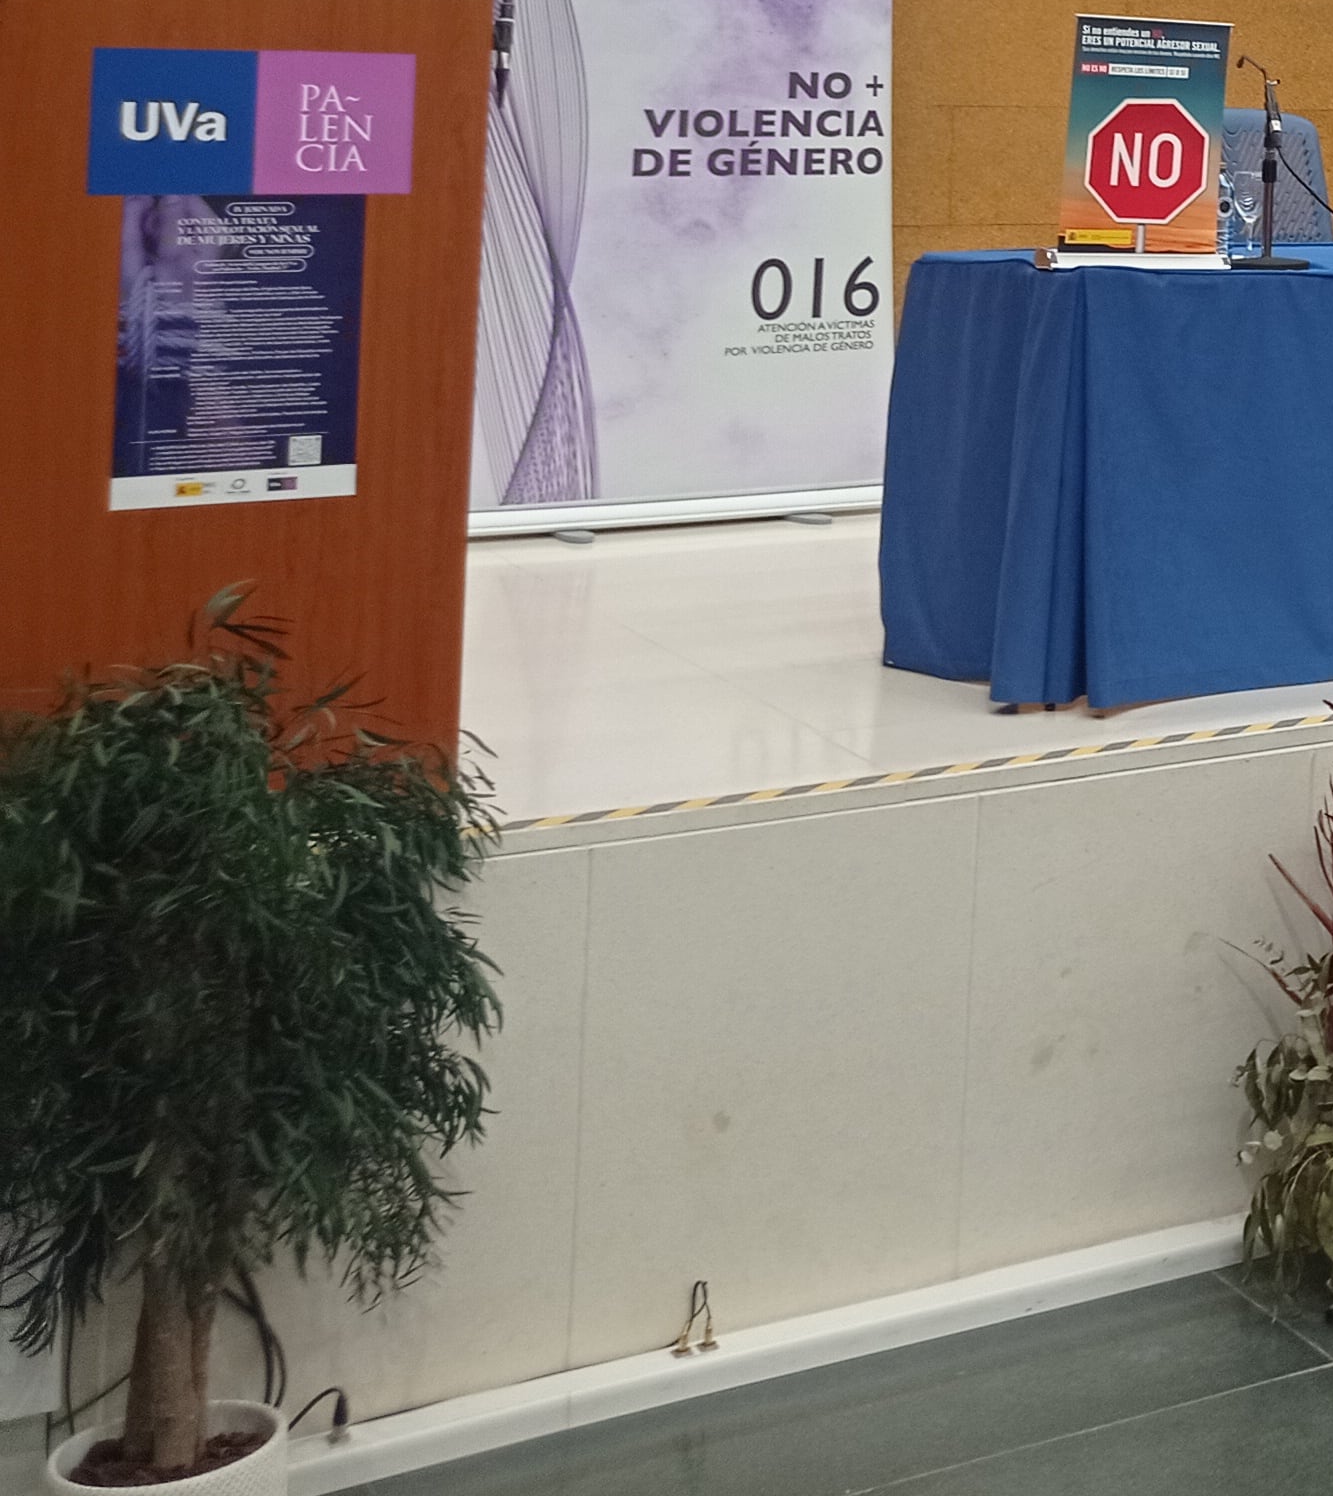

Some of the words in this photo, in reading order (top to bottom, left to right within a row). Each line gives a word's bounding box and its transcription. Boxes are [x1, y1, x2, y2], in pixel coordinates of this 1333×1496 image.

[1082, 35, 1102, 46] ERES
[1103, 36, 1114, 46] UN
[1115, 37, 1155, 49] POTENCIAL
[1156, 40, 1190, 51] AGRESOR
[788, 71, 852, 99] NO
[865, 75, 884, 96] +
[121, 101, 226, 142] UVa
[299, 115, 373, 142] LEN
[644, 109, 885, 137] VIOLENCIA
[296, 144, 367, 172] CIA
[632, 149, 692, 177] DE
[707, 140, 883, 176] GÉNERO
[1110, 132, 1182, 188] NO
[751, 256, 880, 320] 016
[775, 333, 790, 343] DE
[792, 332, 830, 342] MALOS
[832, 330, 872, 340] TRATOS
[818, 322, 826, 331] A
[724, 346, 747, 357] POR
[750, 343, 810, 354] VIOLENCIA
[813, 342, 828, 352] DE
